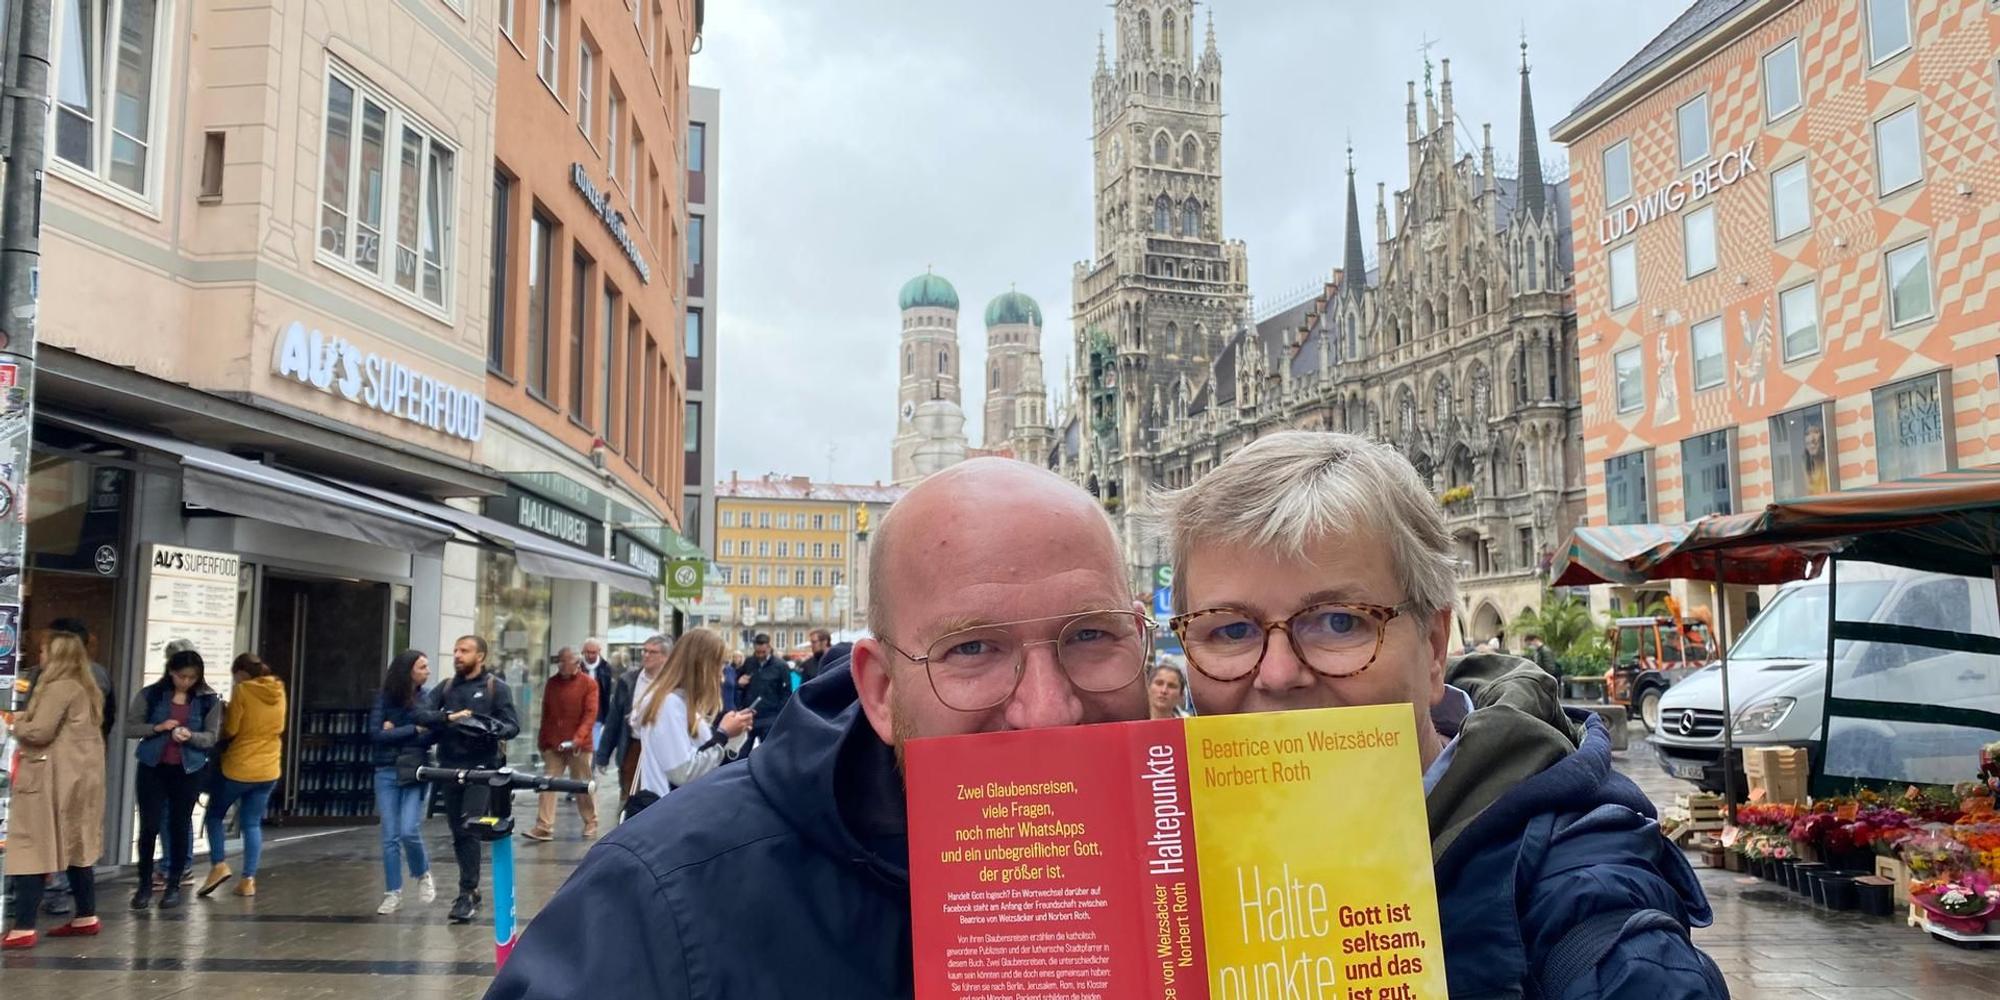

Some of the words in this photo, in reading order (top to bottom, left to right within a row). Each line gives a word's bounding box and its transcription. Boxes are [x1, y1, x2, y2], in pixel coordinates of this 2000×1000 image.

[1599, 180, 1687, 246] LUDWIG
[1691, 140, 1758, 201] BECK
[364, 352, 484, 442] SUPERFOOD
[518, 496, 588, 547] HALLHUBER
[184, 553, 238, 577] SUPERFOOD
[1158, 566, 1172, 587] S
[1159, 591, 1172, 612] U
[1202, 738, 1270, 760] Beatrice
[1274, 738, 1304, 754] von
[1307, 727, 1401, 752] Weizsäcker
[1205, 765, 1268, 788] Norbert
[1272, 760, 1311, 784] Roth
[957, 784, 984, 800] Zwei
[986, 781, 1078, 798] Glaubensreisen,
[982, 803, 1008, 818] viele
[1011, 801, 1055, 819] Fragen,
[1141, 744, 1186, 875] Haltepunkte
[955, 825, 983, 841] noch
[986, 824, 1015, 839] mehr
[1017, 819, 1085, 839] WhatsApps
[941, 846, 962, 863] und
[964, 847, 982, 862] ein
[984, 841, 1071, 862] unbegreiflicher
[1073, 839, 1103, 857] Gott,
[979, 866, 999, 882] der
[1001, 864, 1043, 884] größer
[1046, 864, 1065, 879] ist.
[1171, 881, 1188, 915] Roth
[1237, 863, 1330, 945] Halte
[1153, 883, 1174, 960] Weizsäcker
[1338, 904, 1383, 928] Gott
[1386, 903, 1412, 924] ist
[1177, 916, 1193, 967] Norbert
[1342, 930, 1426, 955] seltsam,
[1160, 960, 1175, 986] von
[1346, 956, 1383, 980] und
[1387, 953, 1423, 976] das
[1347, 984, 1373, 1000] ist
[1379, 982, 1418, 1000] gut.
